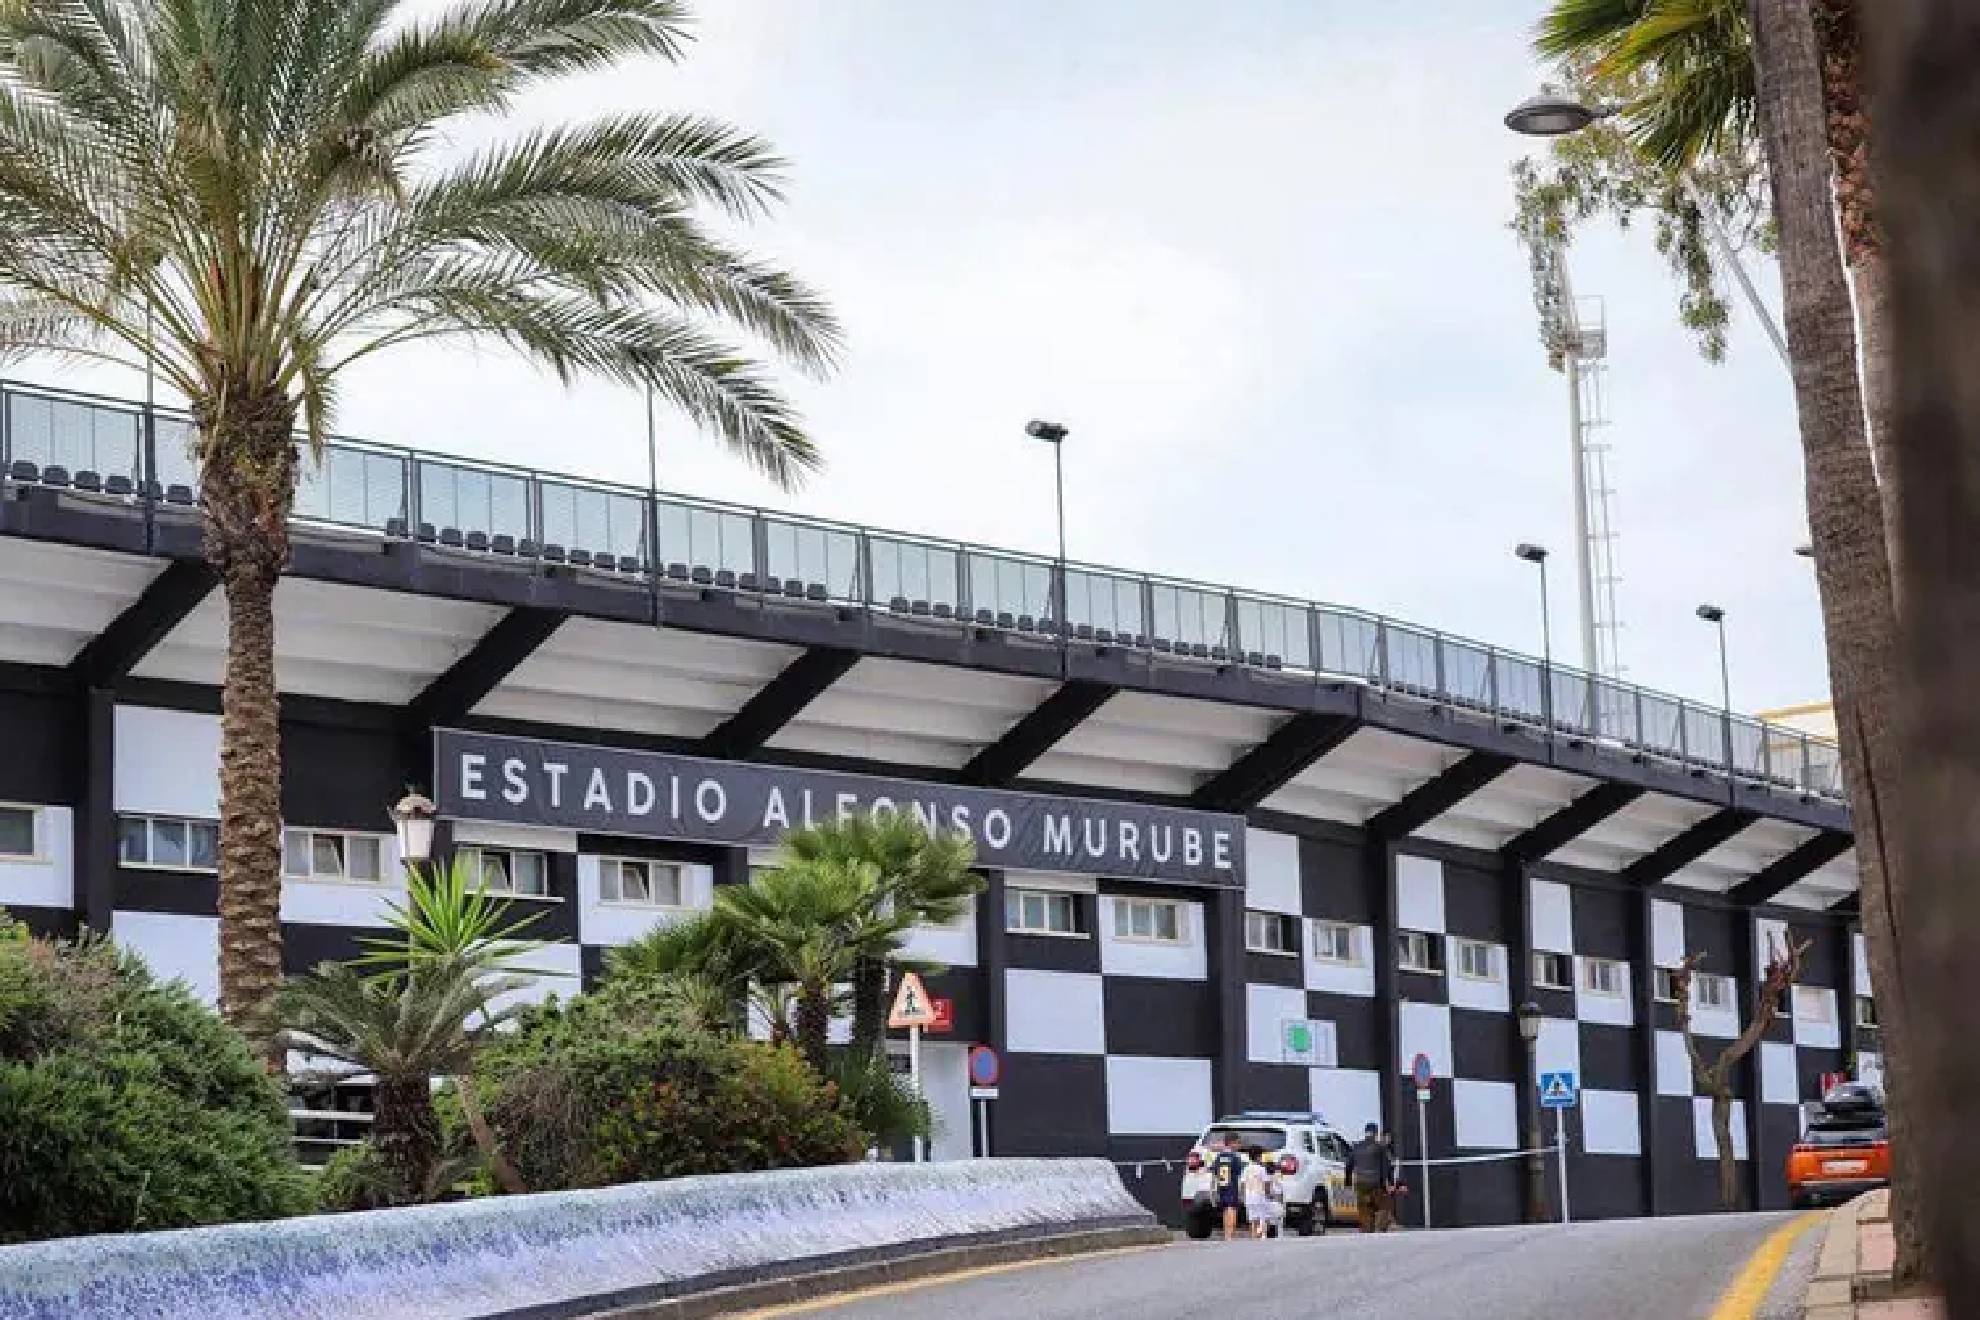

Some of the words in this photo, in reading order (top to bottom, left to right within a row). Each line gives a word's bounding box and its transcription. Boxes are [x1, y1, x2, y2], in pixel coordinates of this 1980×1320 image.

[460, 754, 727, 823] ESTADIO
[763, 786, 1012, 850] ALFONSO
[1043, 814, 1232, 868] MURUBE
